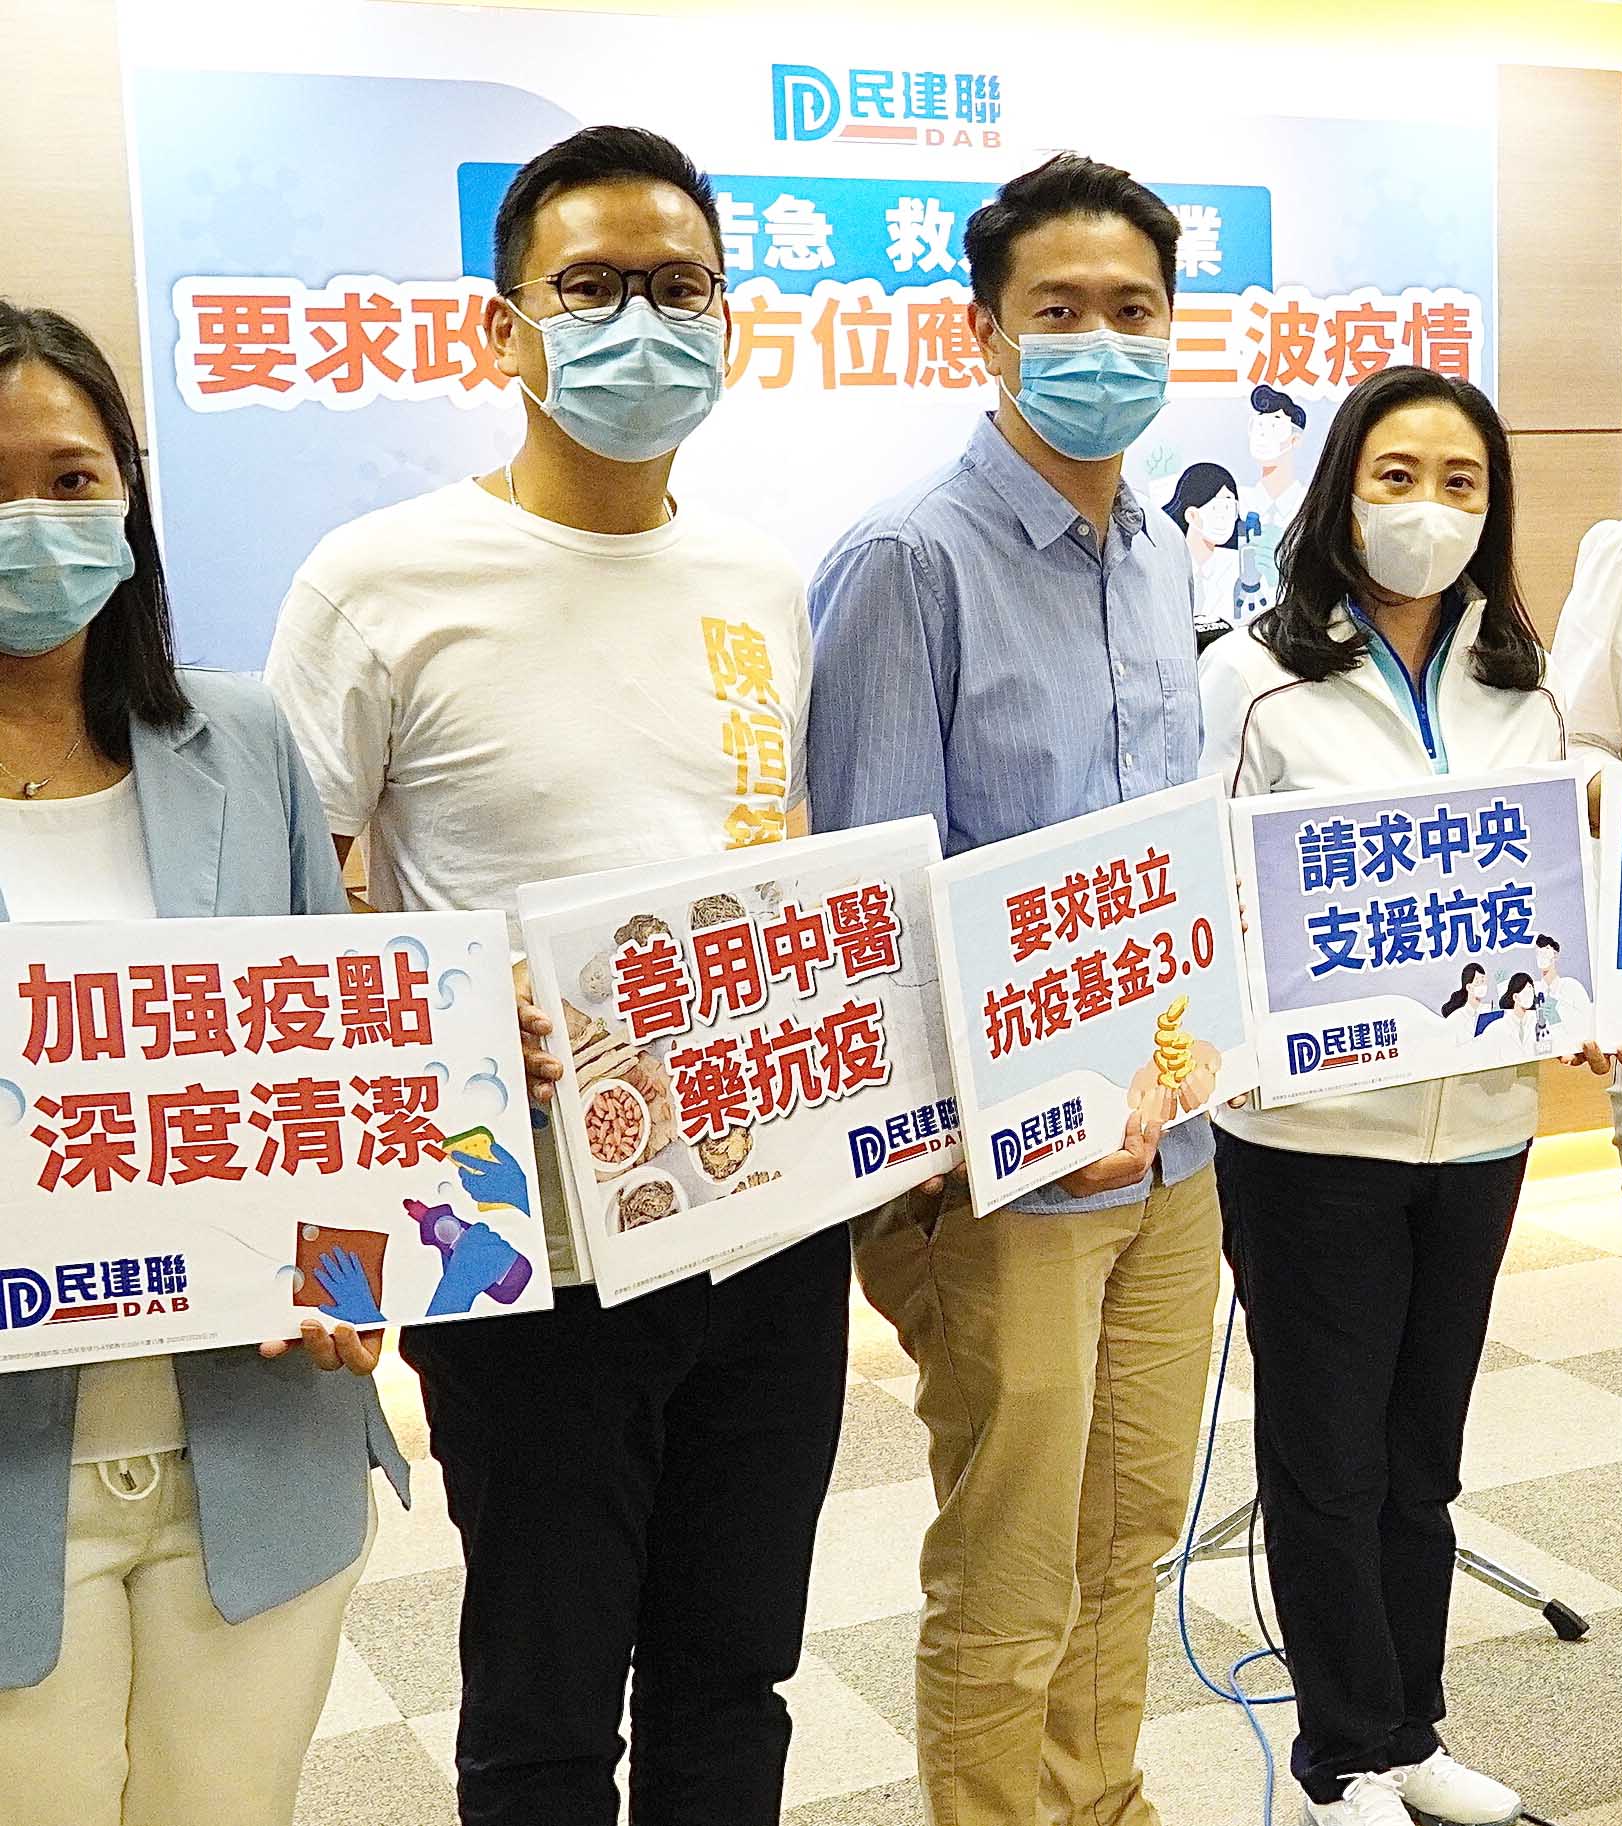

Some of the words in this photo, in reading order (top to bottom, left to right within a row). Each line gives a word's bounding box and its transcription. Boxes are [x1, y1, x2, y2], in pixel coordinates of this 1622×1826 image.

[849, 69, 1000, 124] 民建聯
[926, 128, 1001, 148] DAB
[717, 192, 836, 271] 告急
[1299, 801, 1527, 891] 請求中央
[1006, 846, 1177, 963] 要求設立
[1307, 882, 1535, 977] 支援抗疫
[615, 883, 897, 1039] 善用中醫
[984, 918, 1214, 1060] 抗疫基金3.0
[1322, 1019, 1398, 1055] 民建聯
[1361, 1048, 1399, 1064] DAB
[670, 1002, 888, 1140] 藥抗疫
[30, 1075, 449, 1193] 深度清潔
[886, 1096, 960, 1149] 民建聯
[1020, 1096, 1084, 1149] 民建聯
[1052, 1130, 1087, 1155] DAB
[56, 1254, 188, 1303] 民建聯
[123, 1297, 190, 1317] DAB
